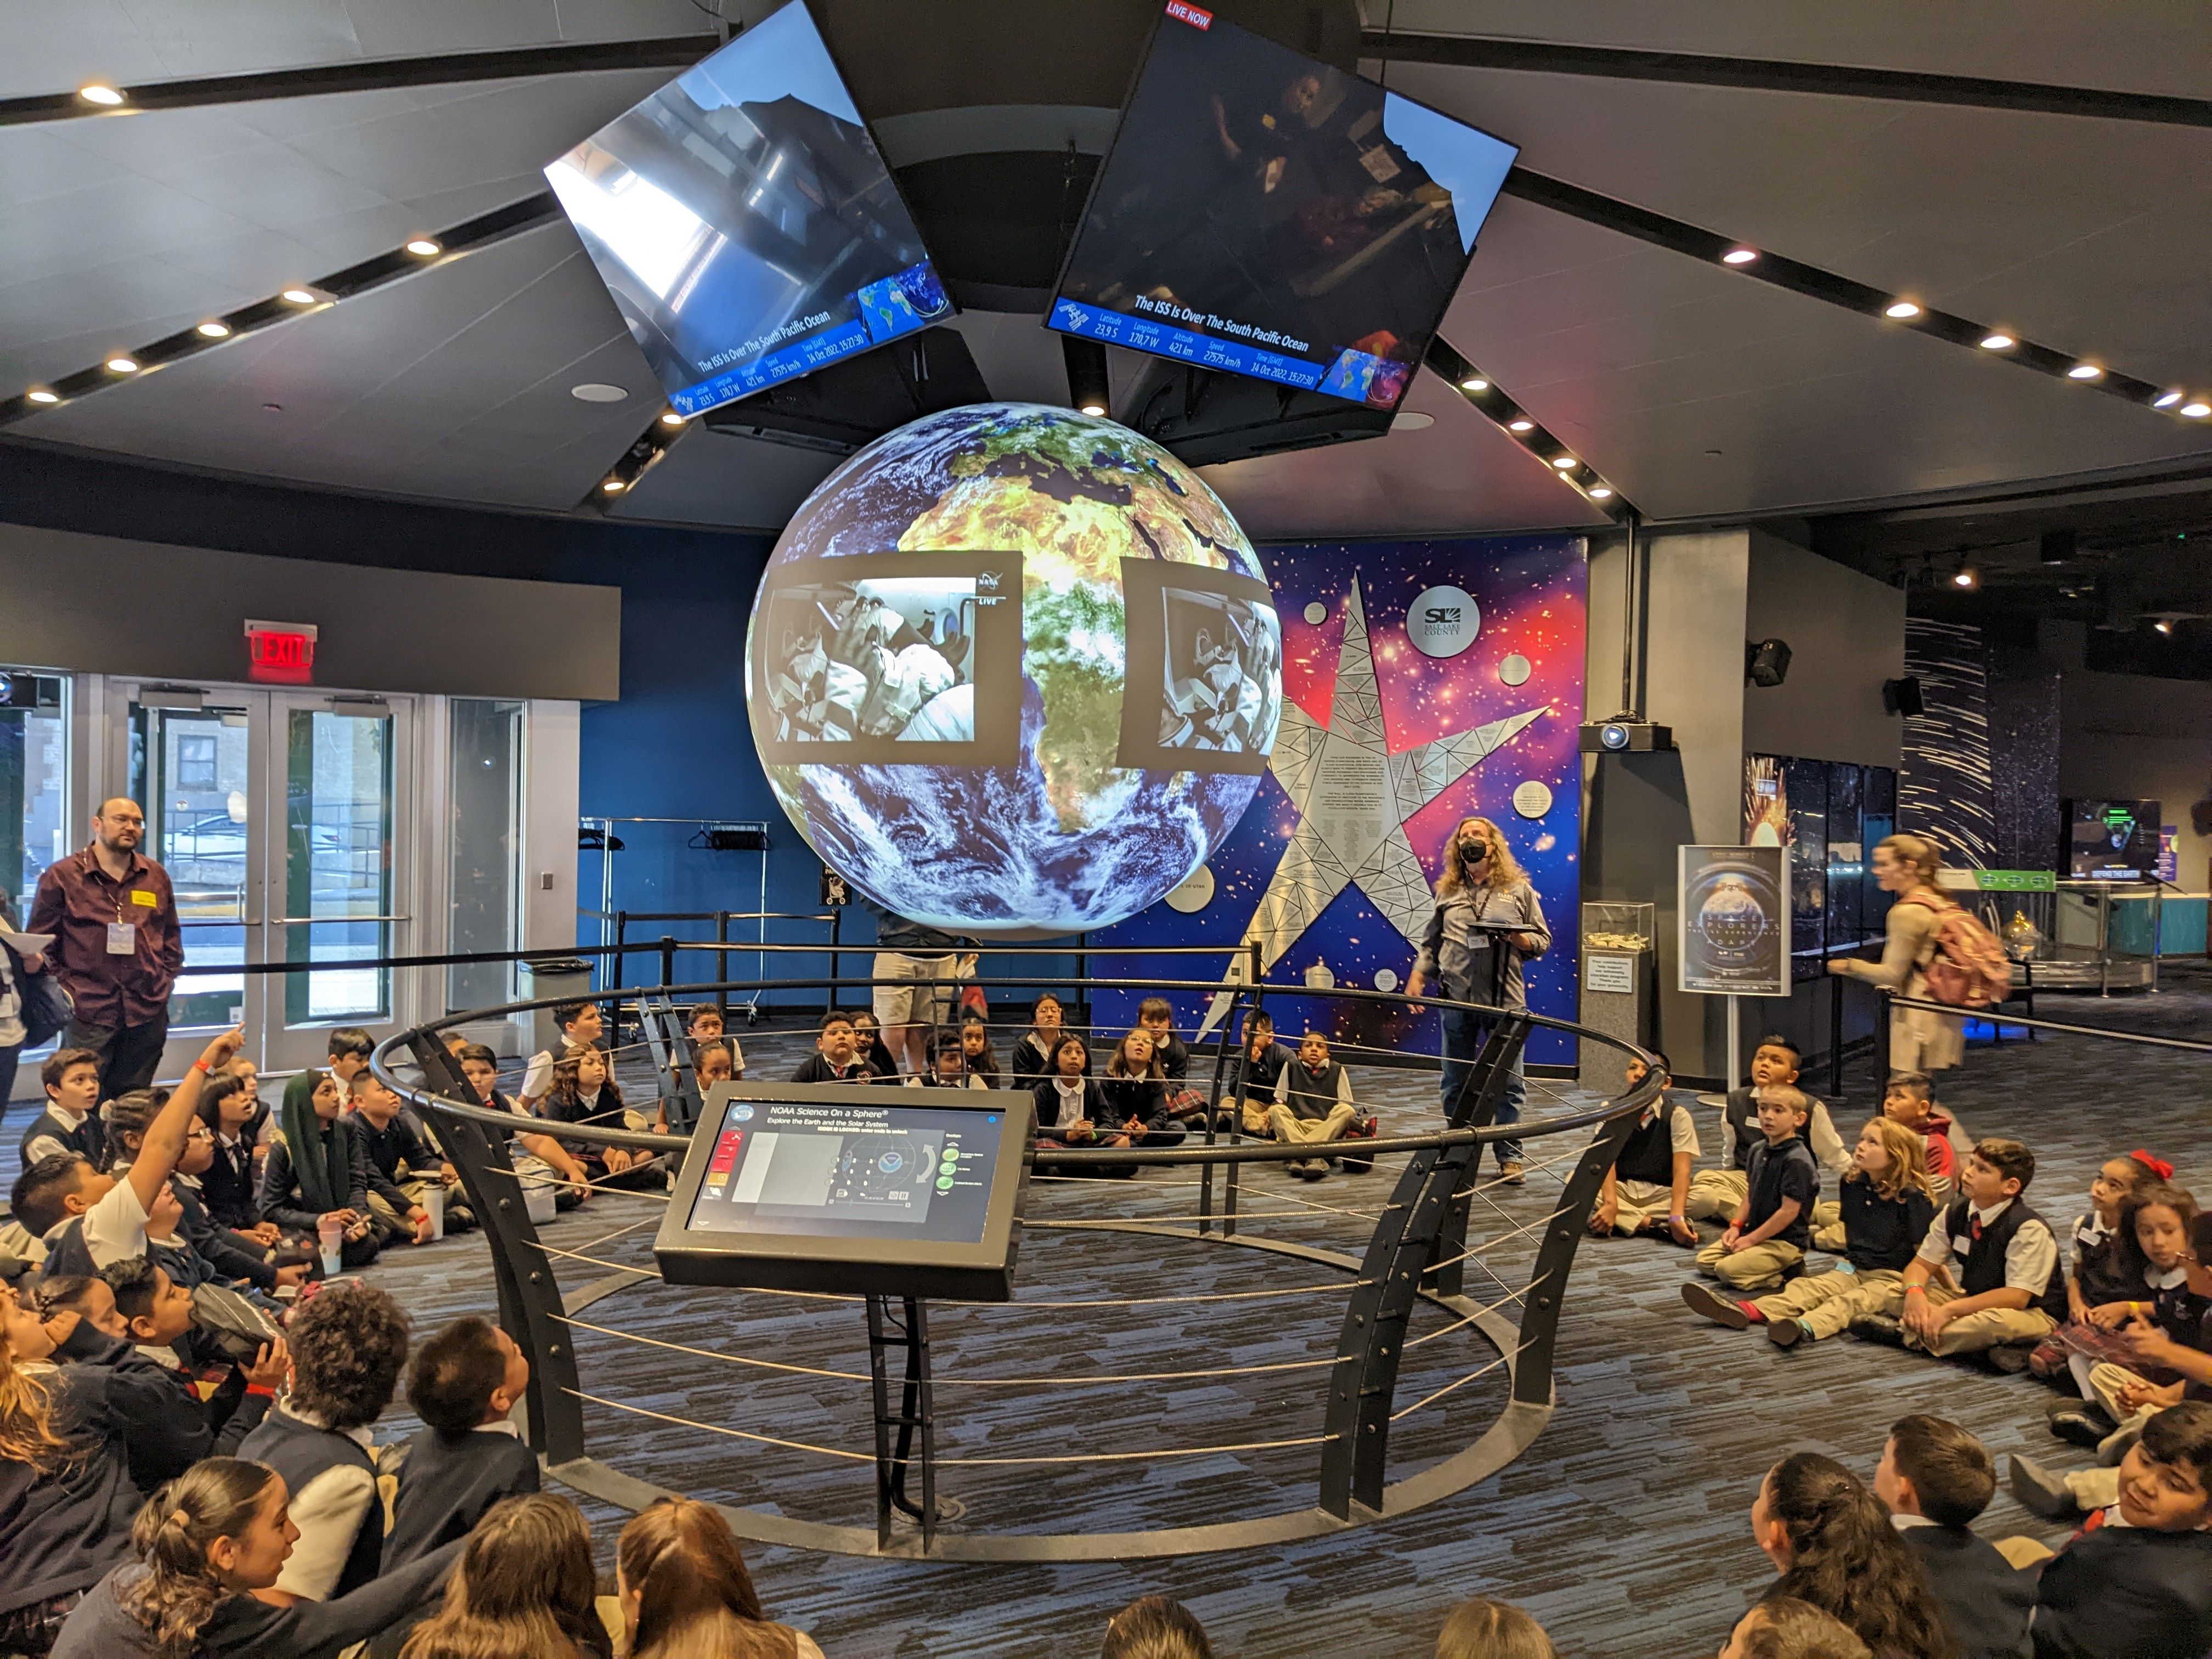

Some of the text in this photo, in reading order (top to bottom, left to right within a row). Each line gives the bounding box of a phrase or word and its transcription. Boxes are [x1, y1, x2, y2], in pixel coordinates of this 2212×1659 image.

[1167, 2, 1210, 27] LIVE NOW
[1099, 313, 1122, 326] Latitude
[1135, 295, 1310, 352] The ISS Is Over The South Pacific Ocean
[1094, 323, 1119, 338] 23,9 S
[1133, 322, 1159, 335] Longitude
[698, 311, 831, 372] The ISS Is Over The South Pacific Ocean
[1128, 332, 1160, 348] 170,7 W
[1173, 332, 1194, 344] Altitude
[1169, 342, 1194, 357] 421 km
[1209, 341, 1224, 351] Speed
[1203, 351, 1241, 368] 27575 km/h
[1251, 362, 1259, 373] 14
[1260, 364, 1271, 375] Oct
[1271, 367, 1288, 381] 2022,
[263, 633, 305, 665] EXIT
[1688, 921, 1780, 930] EXPLORERS
[770, 1106, 794, 1115] NOAA
[797, 1107, 828, 1116] Science
[831, 1109, 843, 1117] On
